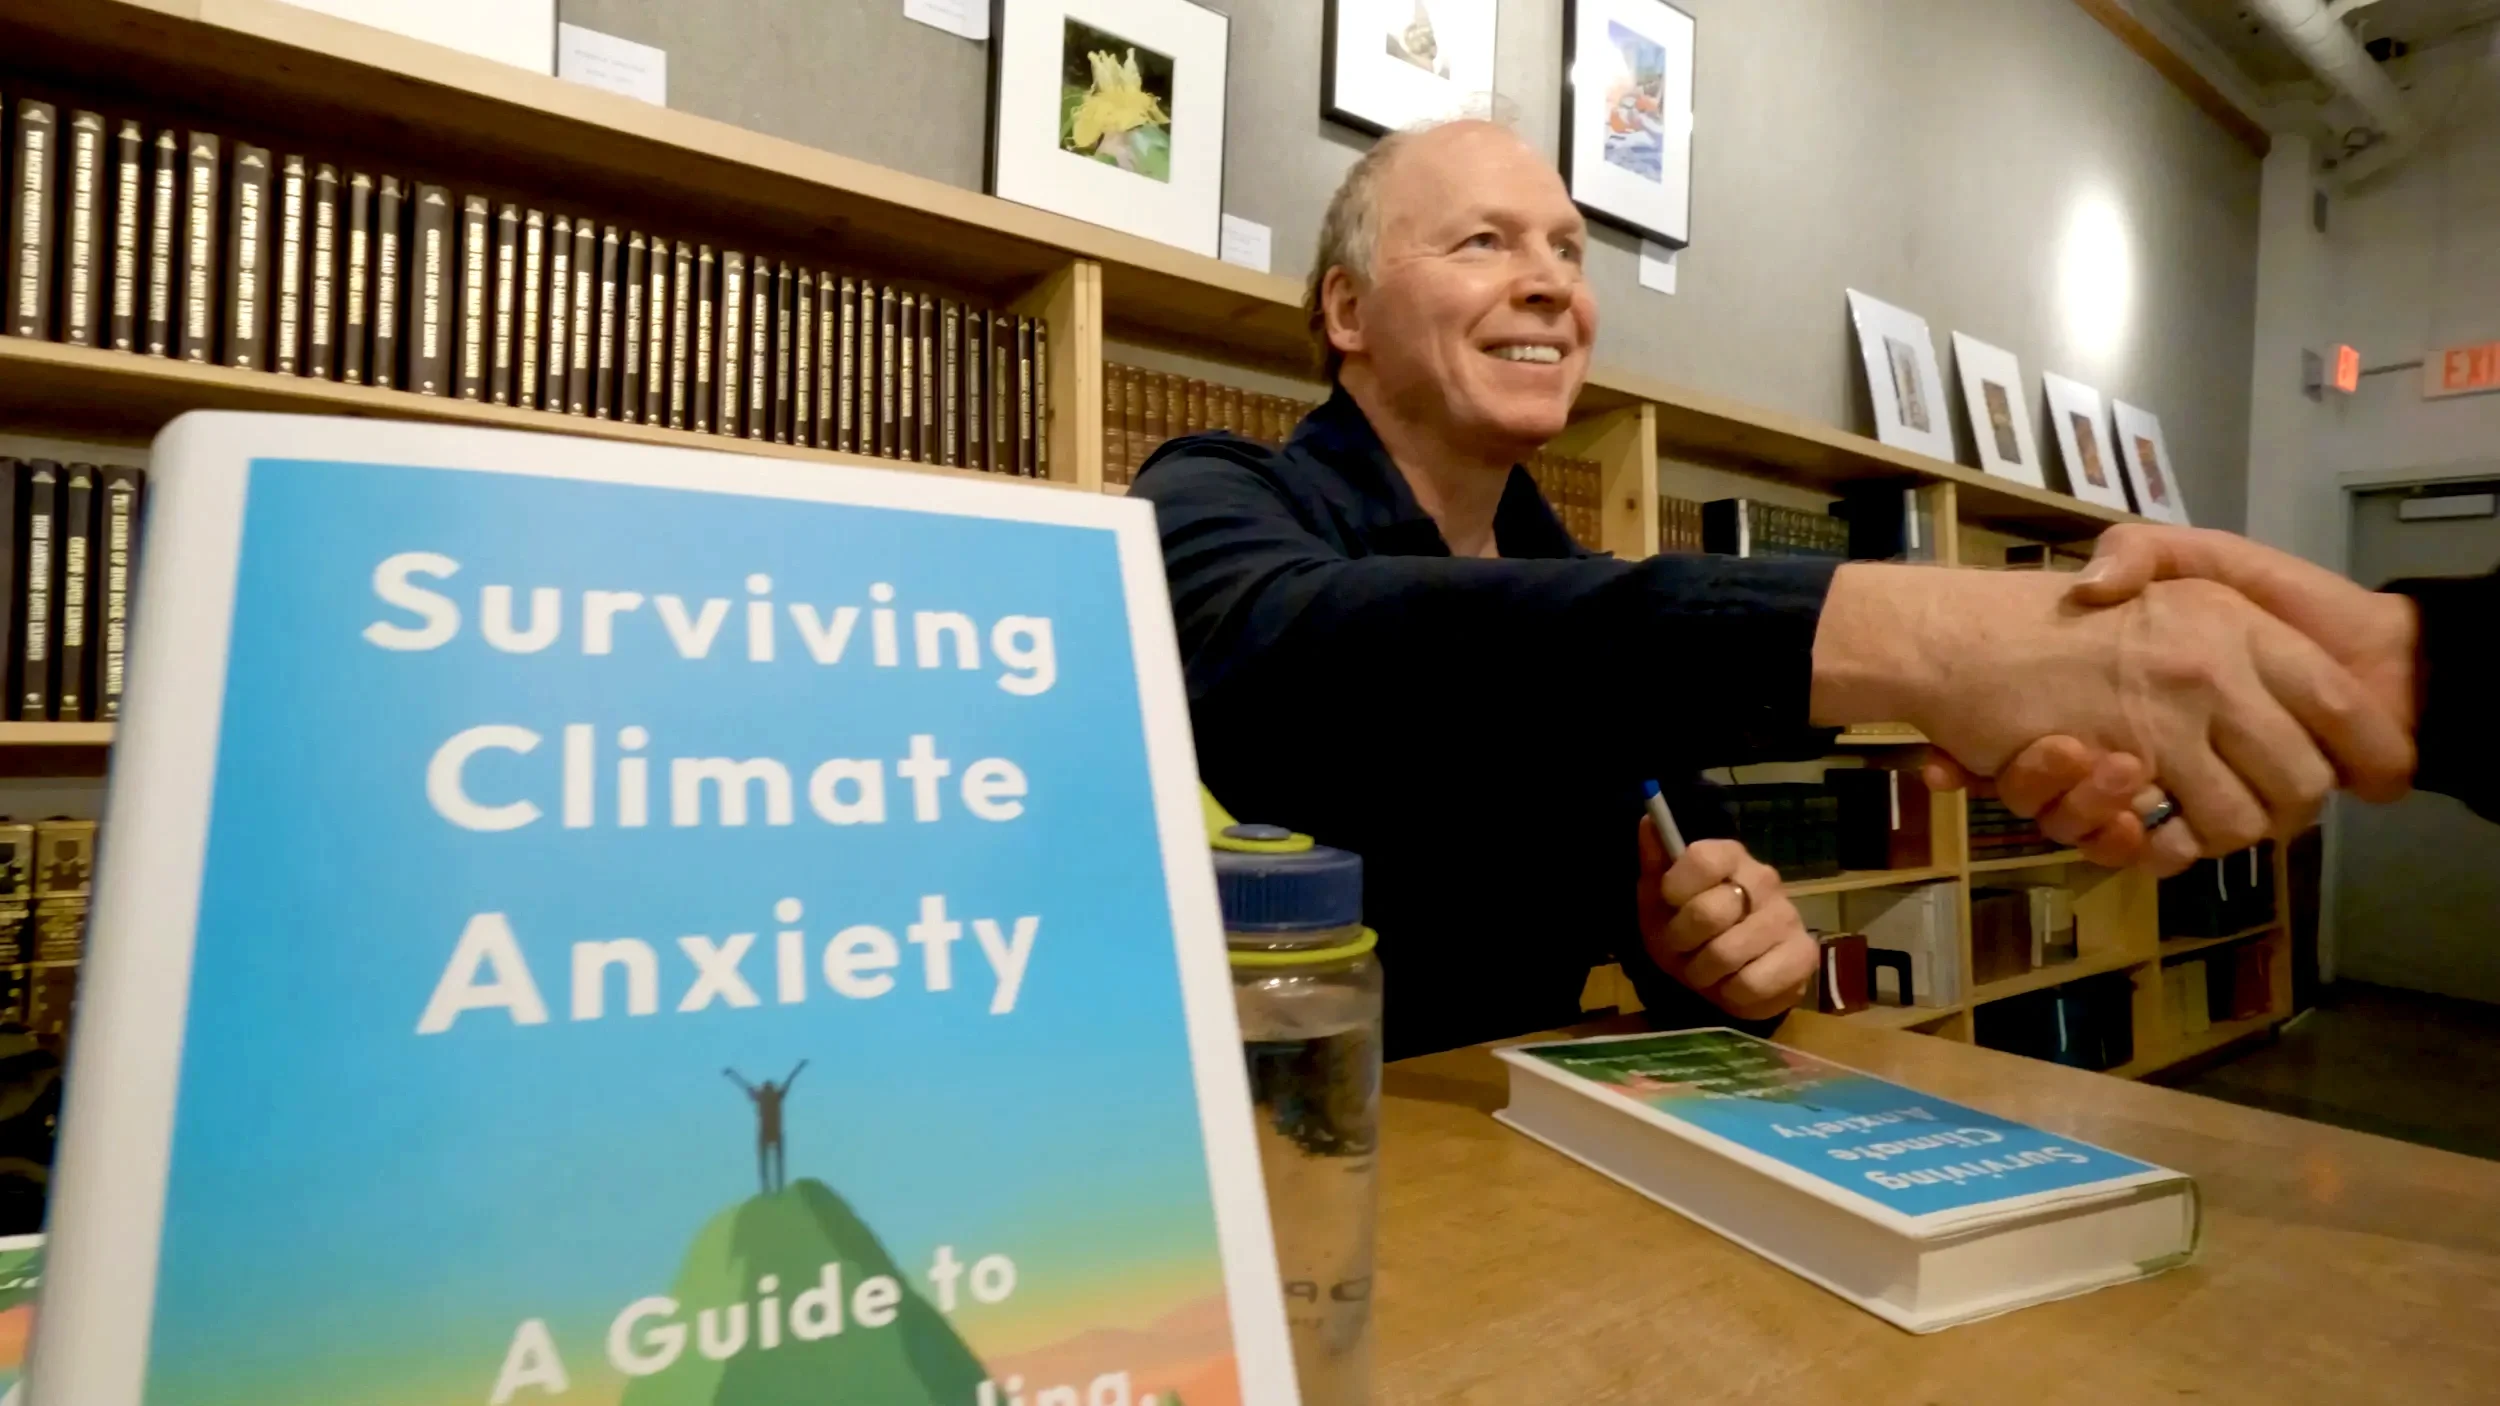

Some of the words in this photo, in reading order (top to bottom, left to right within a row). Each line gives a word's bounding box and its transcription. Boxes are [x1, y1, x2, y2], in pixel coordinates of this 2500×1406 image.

[362, 551, 1057, 696] Surviving
[425, 724, 1029, 831] Climate
[415, 895, 1041, 1034] Anxiety
[1770, 1106, 1939, 1139] Anxiety
[1827, 1127, 2004, 1161] Climate
[1864, 1146, 2089, 1189] Surviving
[490, 1317, 569, 1405] A
[606, 1261, 902, 1376] Guide
[928, 1245, 1018, 1313] to
